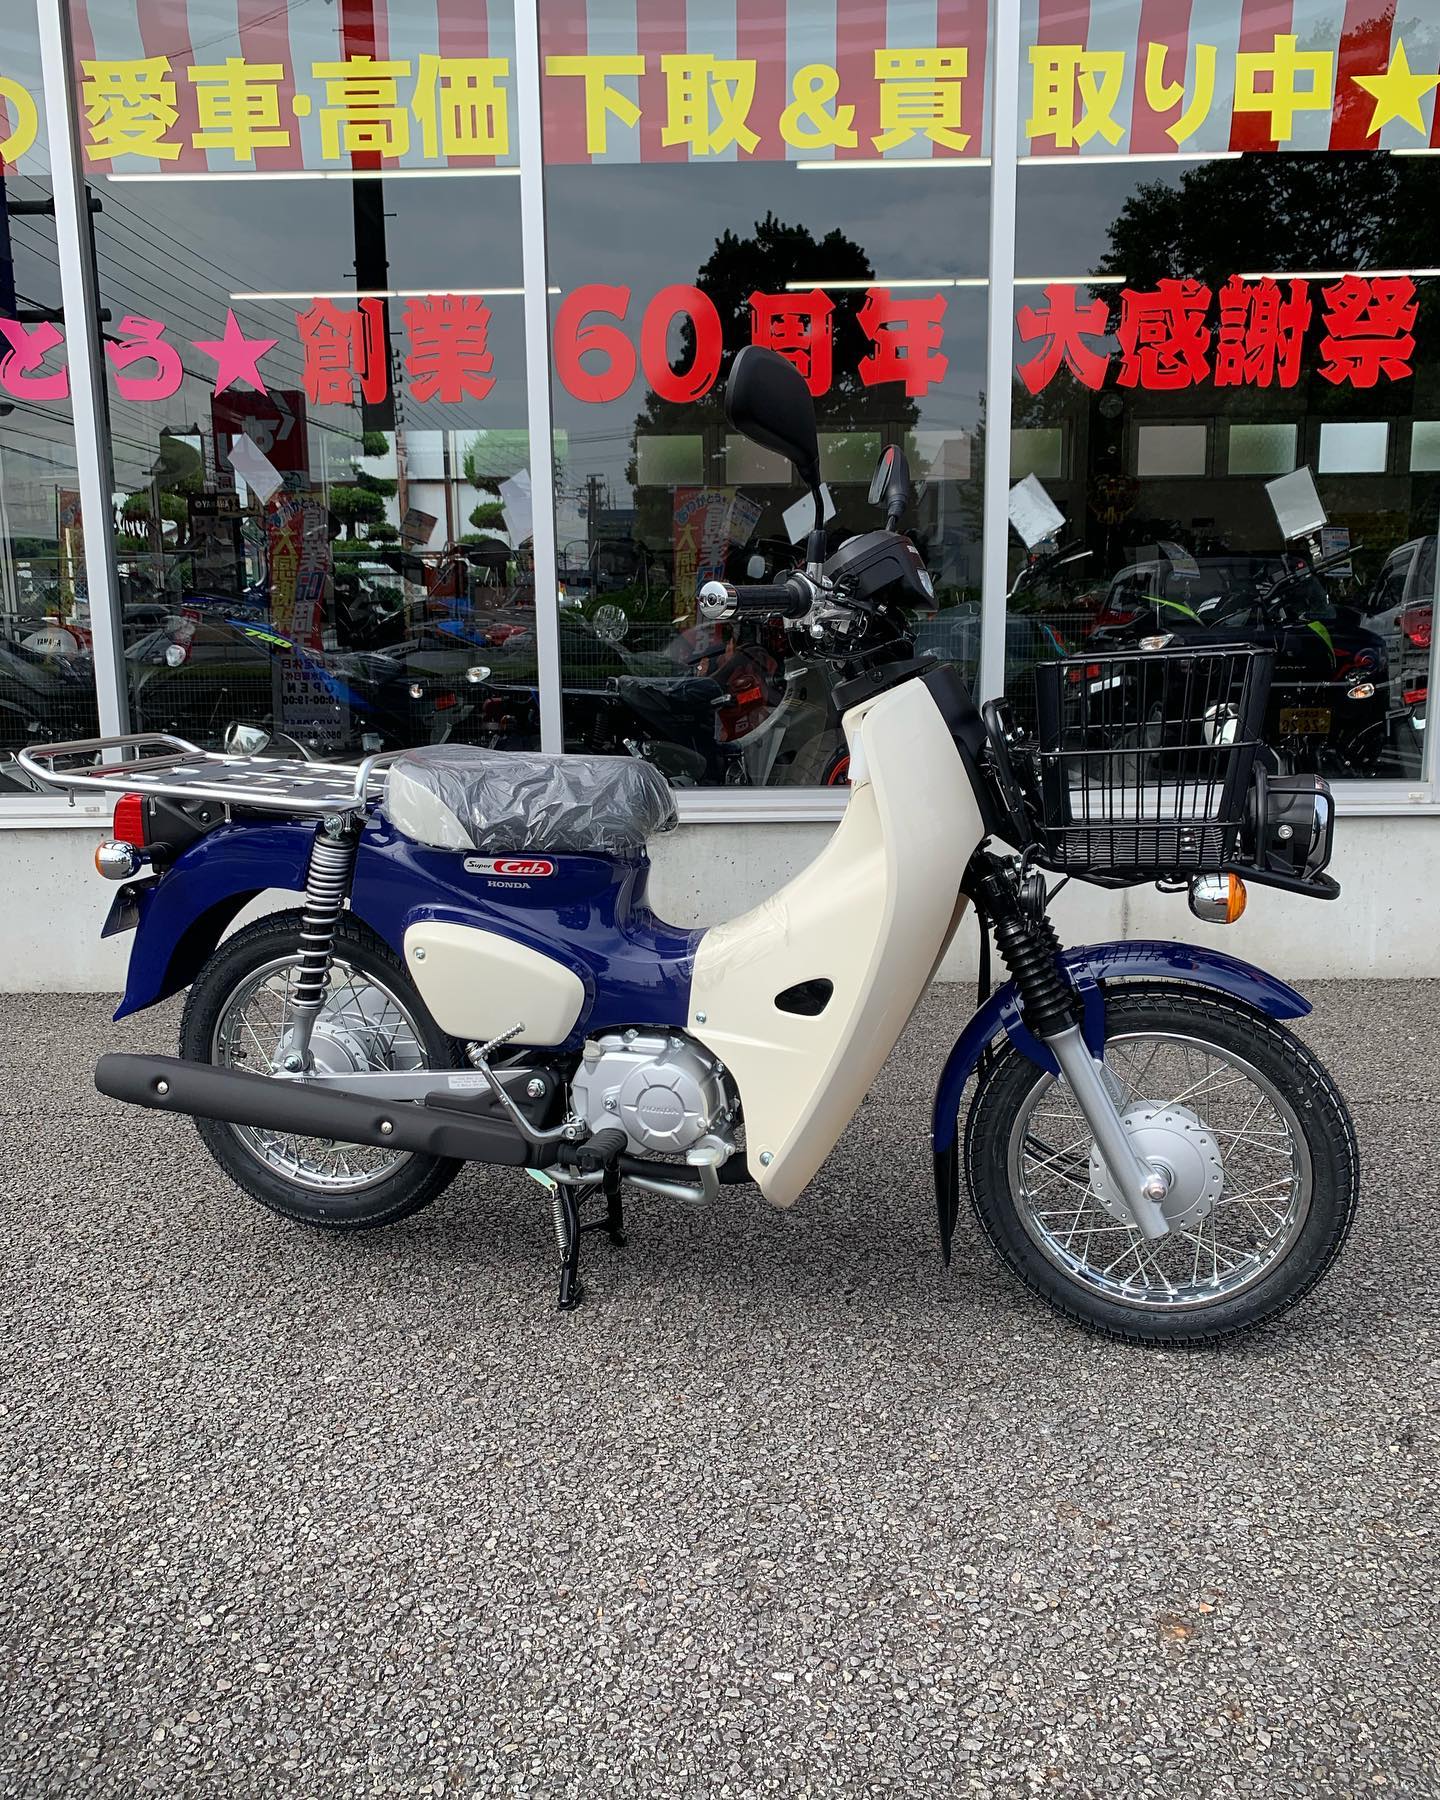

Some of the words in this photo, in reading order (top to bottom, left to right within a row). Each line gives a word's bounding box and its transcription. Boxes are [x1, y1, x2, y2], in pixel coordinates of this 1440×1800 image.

[296, 292, 497, 405] 創業
[1015, 274, 1421, 396] 大感謝祭
[466, 860, 492, 869] Super
[500, 861, 545, 874] Cub
[487, 880, 531, 889] HONDA
